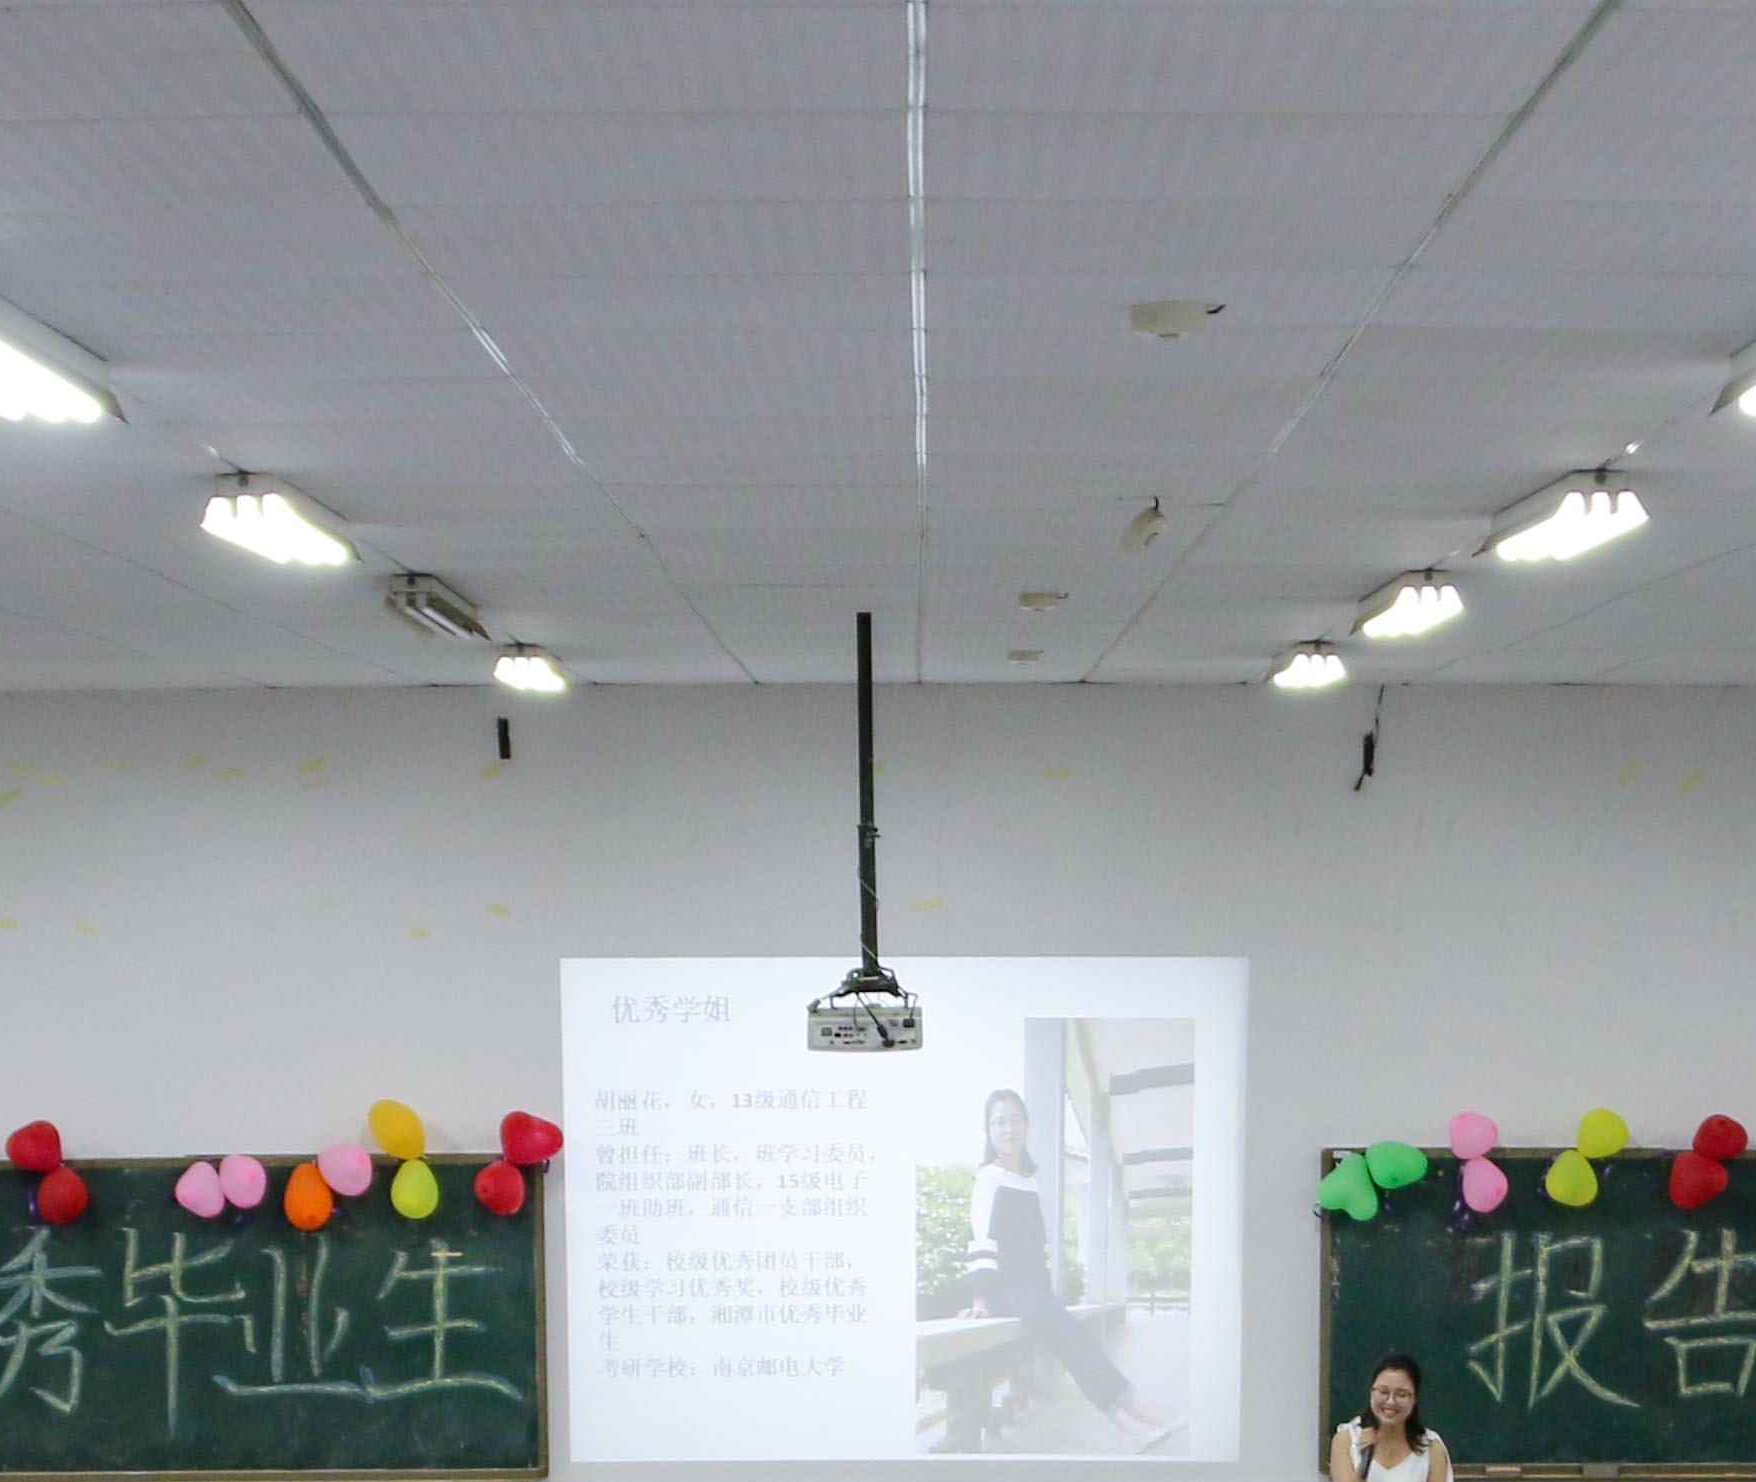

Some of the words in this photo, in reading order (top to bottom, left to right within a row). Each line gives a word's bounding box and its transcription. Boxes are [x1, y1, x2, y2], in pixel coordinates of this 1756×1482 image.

[610, 993, 731, 1025] 优秀学姐
[595, 1117, 639, 1137] 三班
[597, 1224, 640, 1246] 委员
